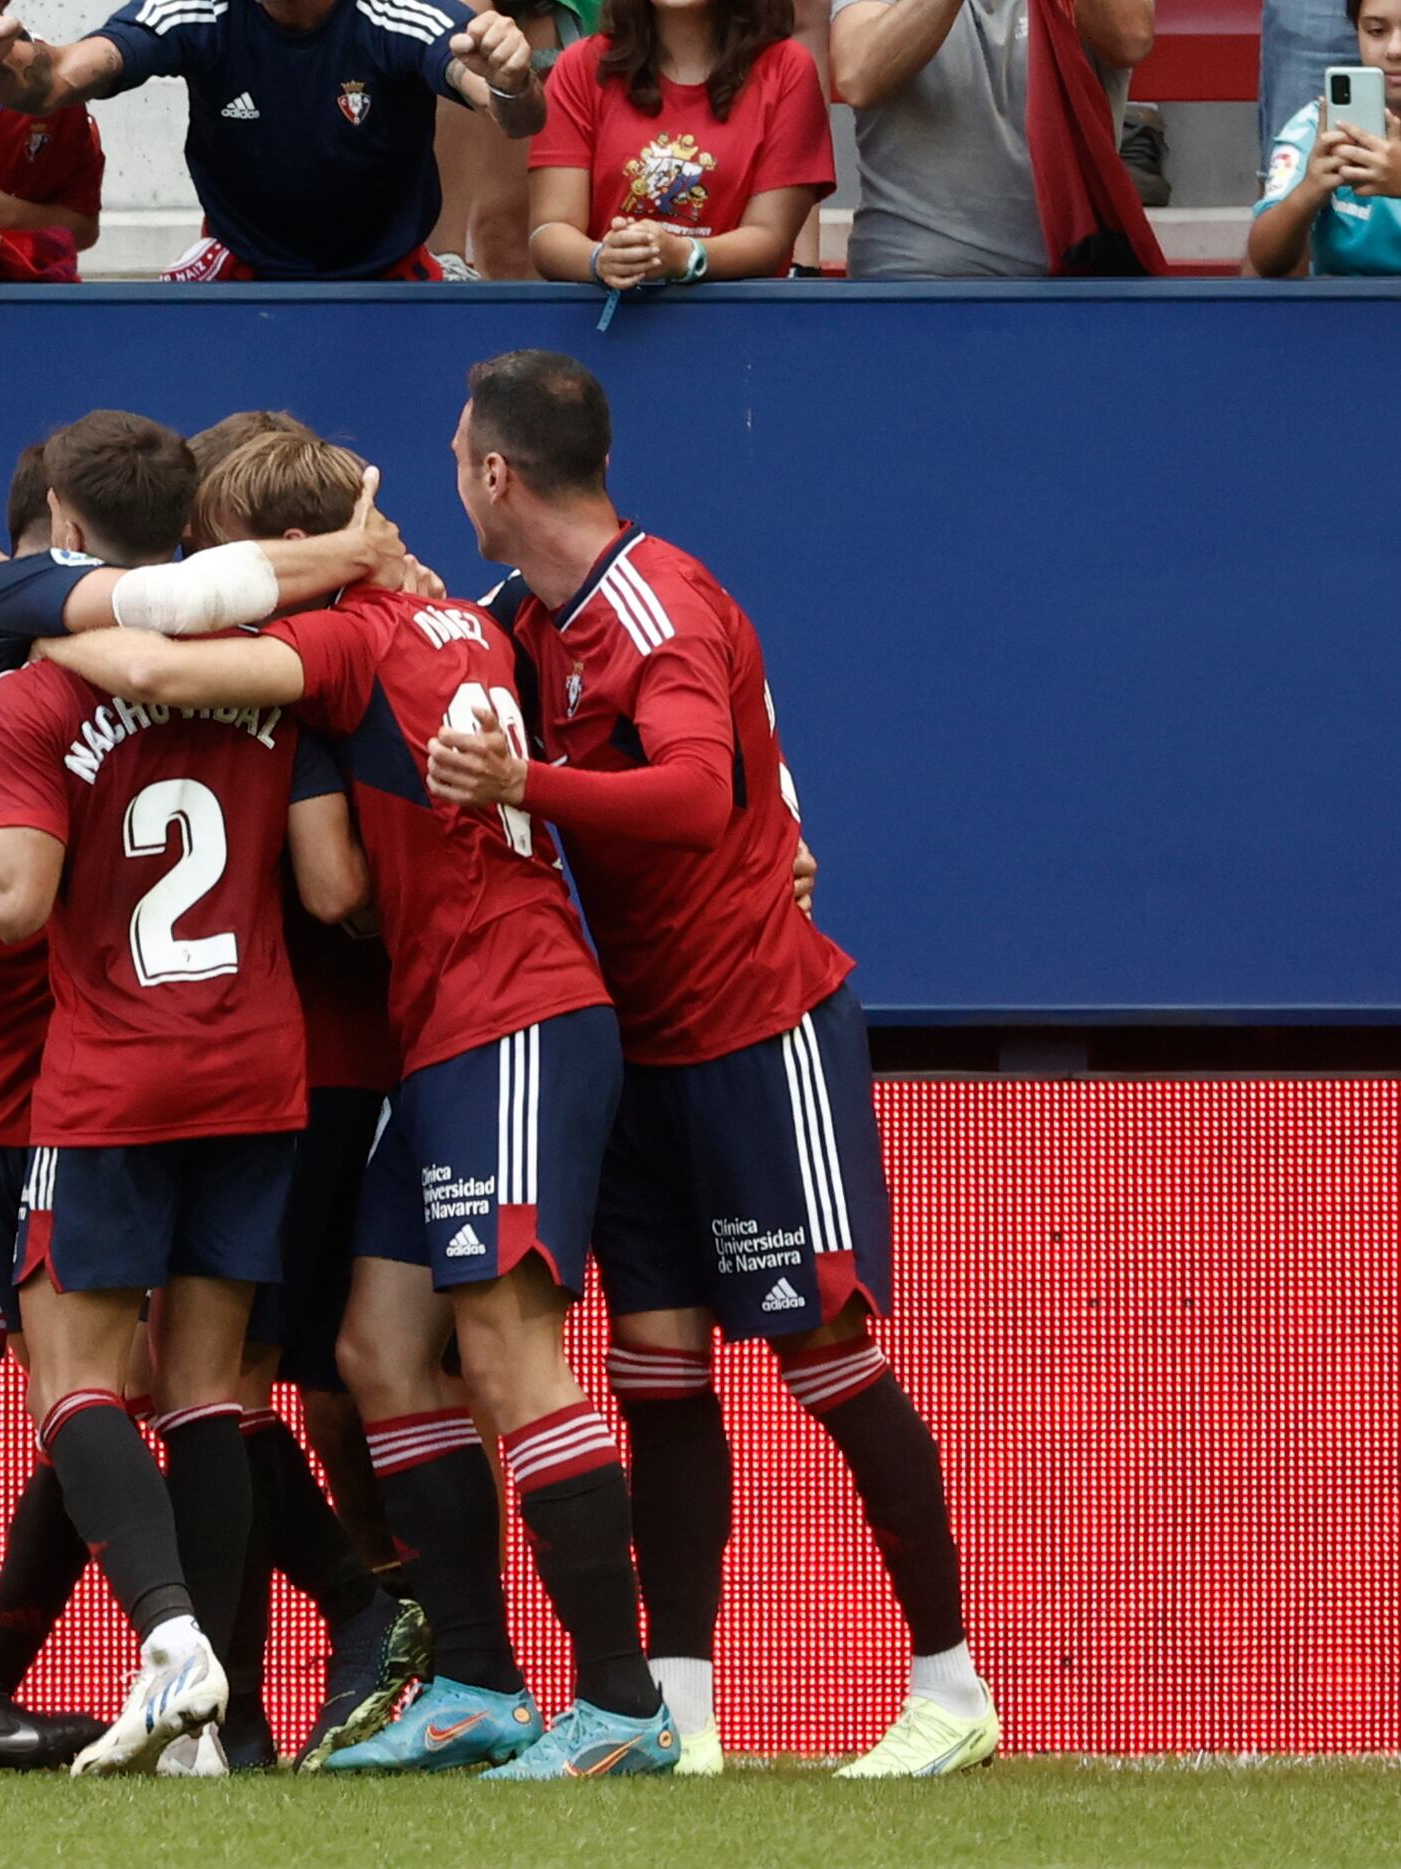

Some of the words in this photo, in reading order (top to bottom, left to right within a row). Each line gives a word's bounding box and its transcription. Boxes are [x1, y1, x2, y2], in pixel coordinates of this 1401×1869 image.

[220, 108, 261, 120] adidas
[63, 696, 171, 785] NACHO
[123, 777, 239, 987] 2
[431, 1200, 490, 1220] Navarra
[711, 1217, 758, 1237] Clínica
[446, 1244, 486, 1257] adidas
[714, 1225, 806, 1256] Universidad
[718, 1255, 734, 1274] de
[735, 1250, 802, 1273] Navarra
[761, 1296, 806, 1312] adidas
